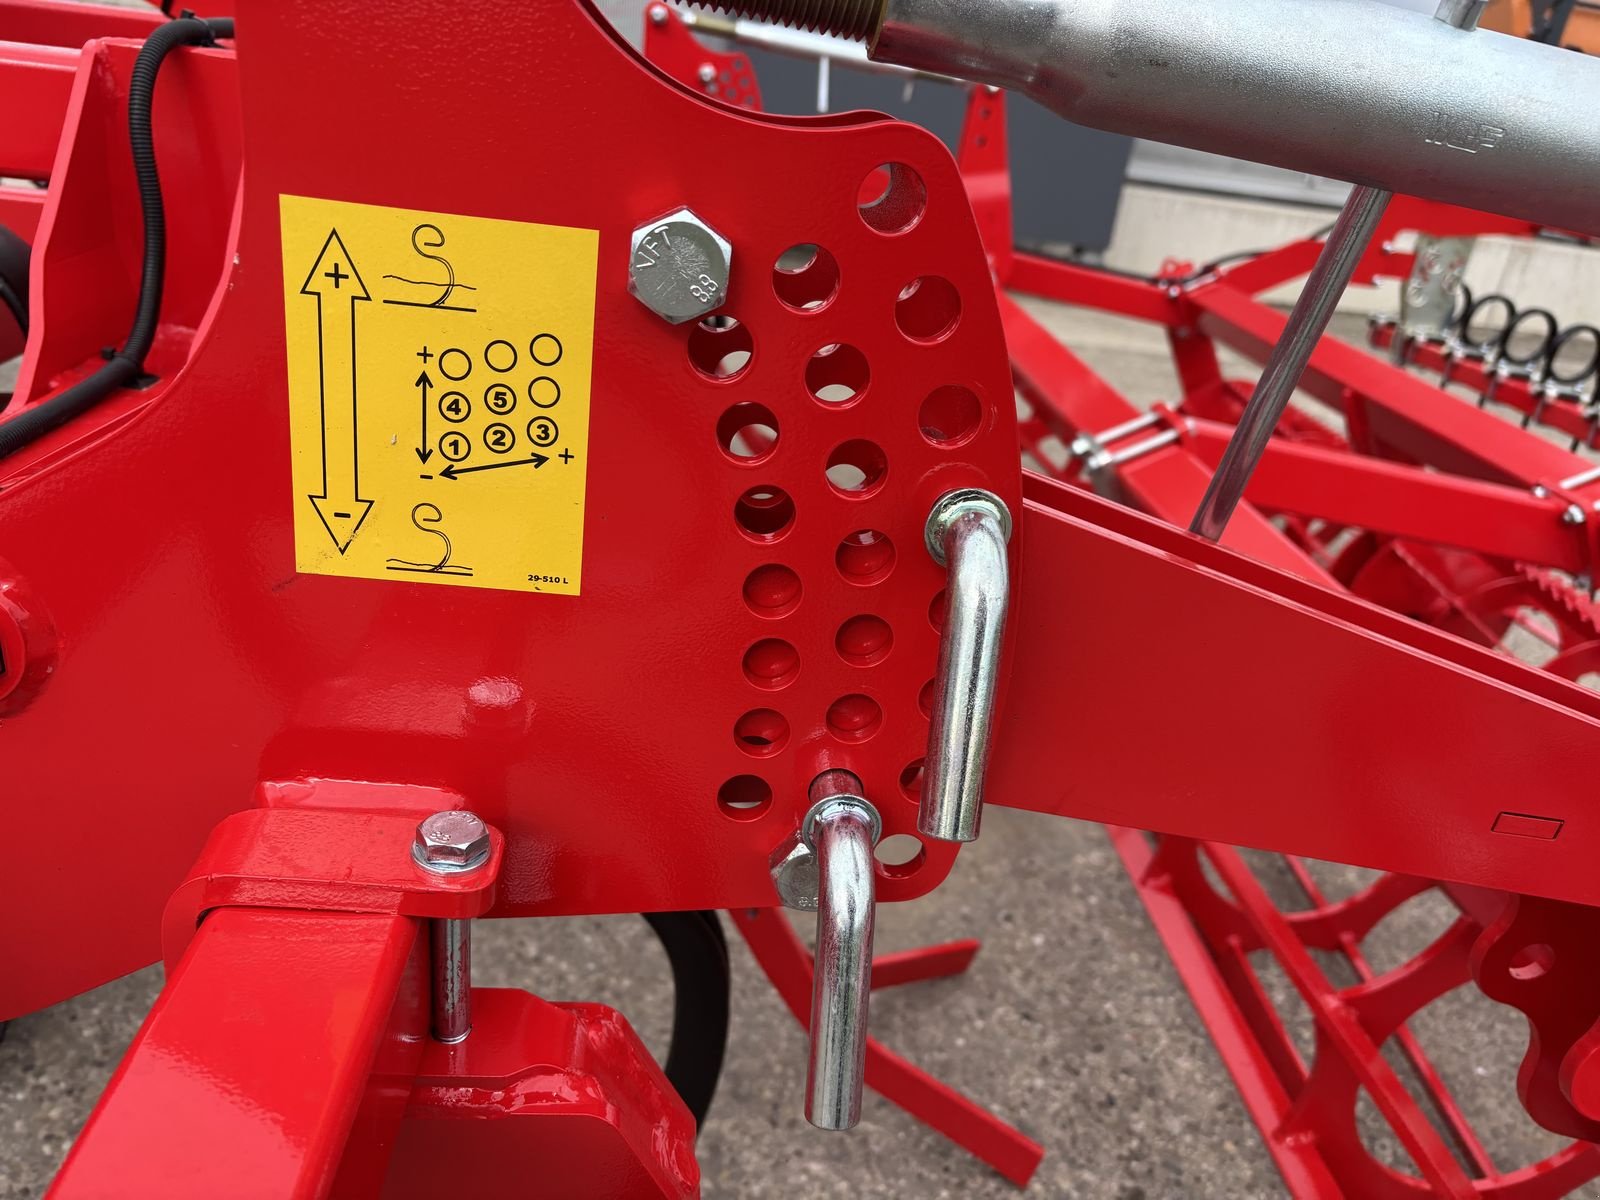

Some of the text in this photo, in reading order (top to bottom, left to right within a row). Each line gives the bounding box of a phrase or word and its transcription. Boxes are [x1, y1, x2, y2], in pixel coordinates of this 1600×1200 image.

[635, 225, 670, 269] VFT
[446, 391, 508, 416] 4 5
[448, 423, 550, 456] 1 2 3
[527, 574, 569, 585] 29-510 L
